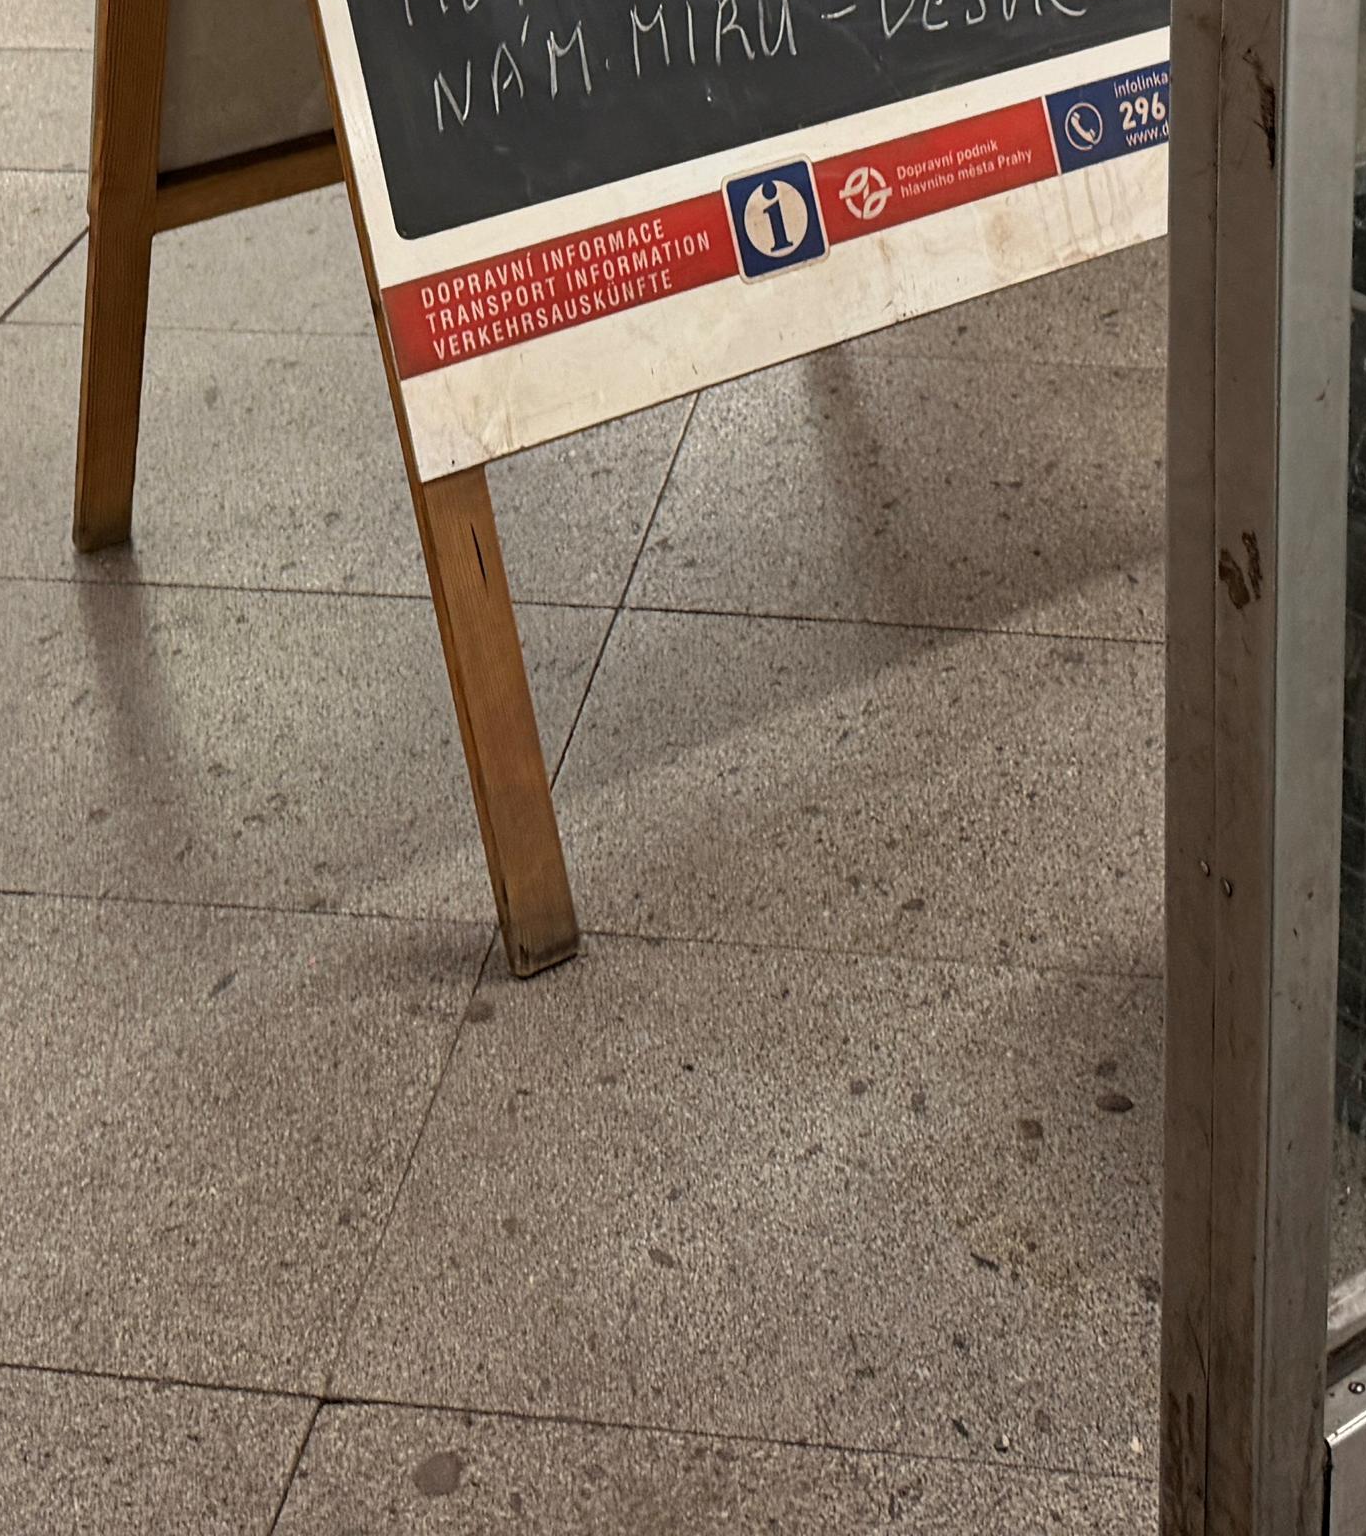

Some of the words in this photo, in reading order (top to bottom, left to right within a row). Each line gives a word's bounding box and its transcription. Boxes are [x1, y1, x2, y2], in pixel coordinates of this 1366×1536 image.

[1113, 72, 1168, 99] infolinka
[1118, 92, 1166, 132] 296
[895, 150, 955, 181] Dopravní
[955, 138, 999, 165] podnik
[899, 171, 956, 199] hlavního
[957, 161, 995, 182] města
[997, 147, 1033, 169] Prahy
[420, 250, 534, 310] DOPRAVNÍ
[541, 217, 666, 275] INFORMACE
[425, 276, 557, 335] TRANSPORT
[566, 229, 711, 293] INFORMATION
[432, 267, 674, 361] VERKEHRSAUSKÜNFTE
